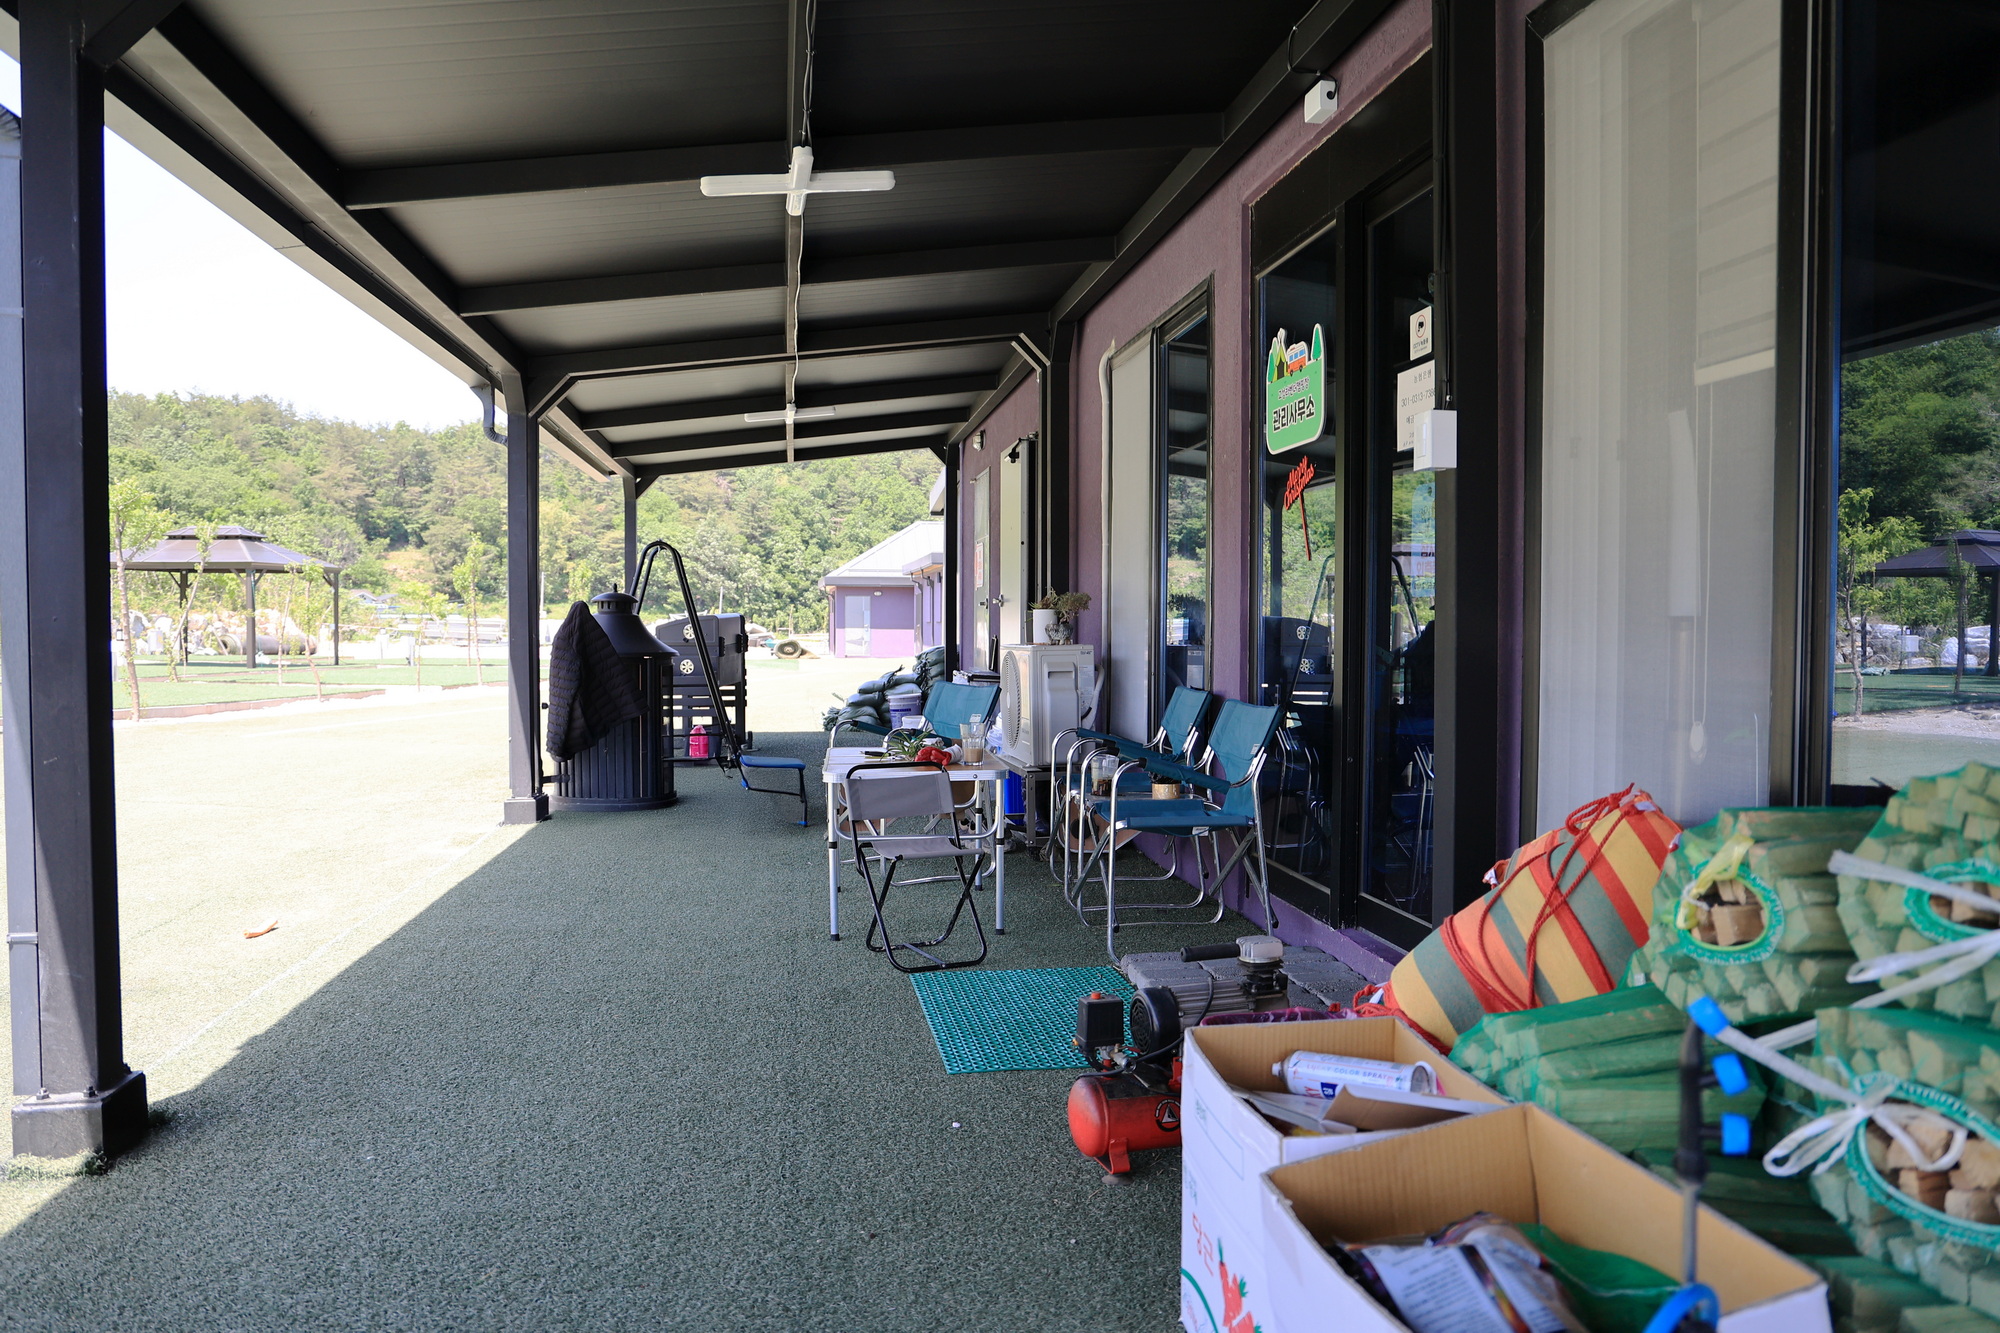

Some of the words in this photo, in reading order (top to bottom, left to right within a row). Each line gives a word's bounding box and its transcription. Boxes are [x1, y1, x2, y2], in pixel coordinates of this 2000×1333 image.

[1273, 394, 1315, 432] 관리사무소
[1333, 1067, 1360, 1076] COLOR
[1362, 1071, 1387, 1080] SPRAY
[1192, 1212, 1214, 1277] 당근
